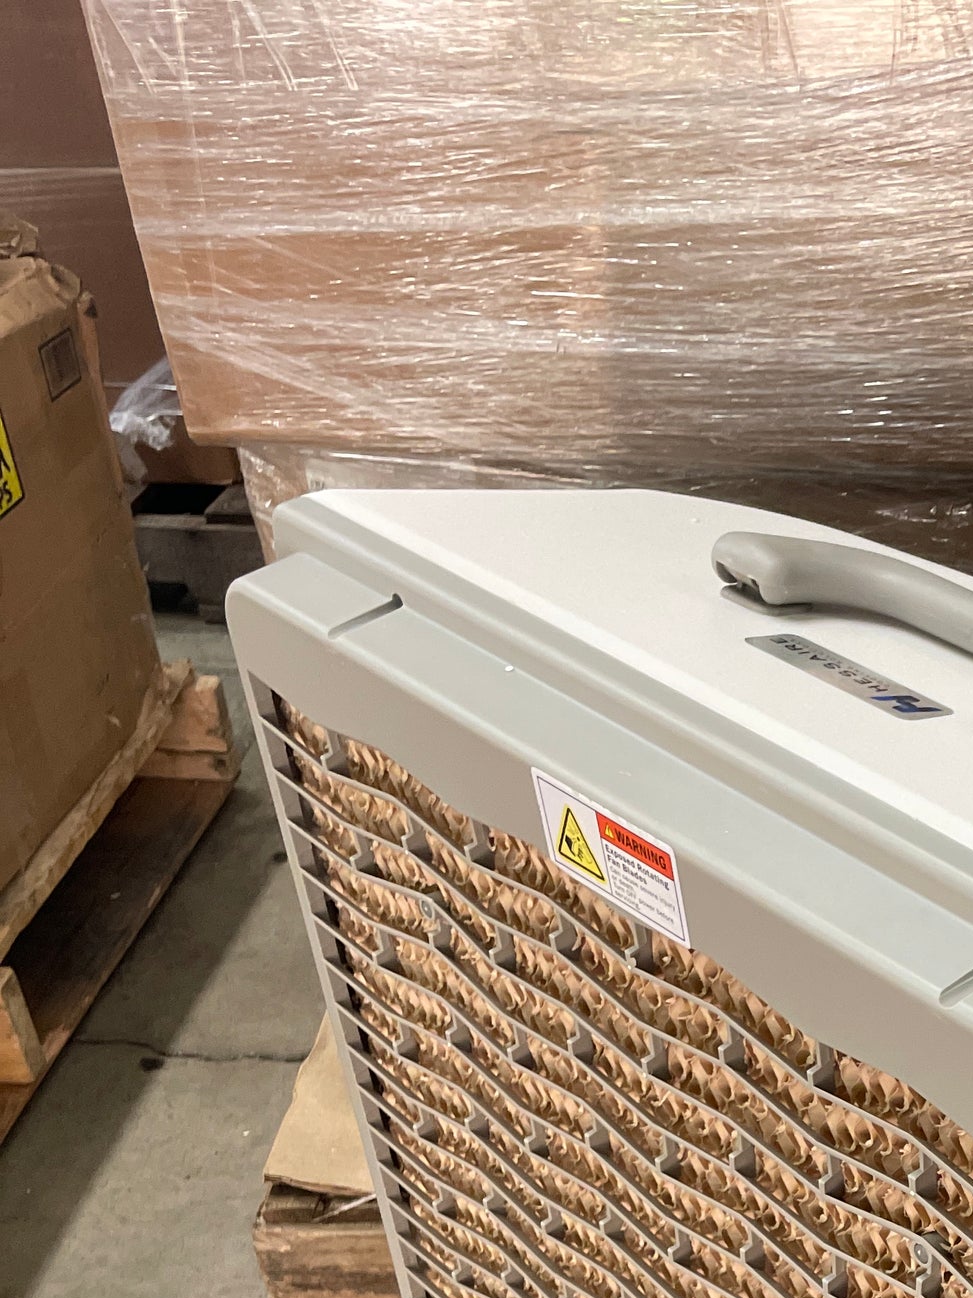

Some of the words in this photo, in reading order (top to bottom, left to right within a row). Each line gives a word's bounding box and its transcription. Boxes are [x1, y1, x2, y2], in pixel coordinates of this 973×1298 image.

[769, 637, 888, 693] HESSAIRE
[605, 843, 635, 868] Exposed
[637, 863, 669, 890] Rotating
[607, 854, 620, 868] Fan
[622, 863, 647, 885] Blades
[614, 829, 667, 870] WARNING
